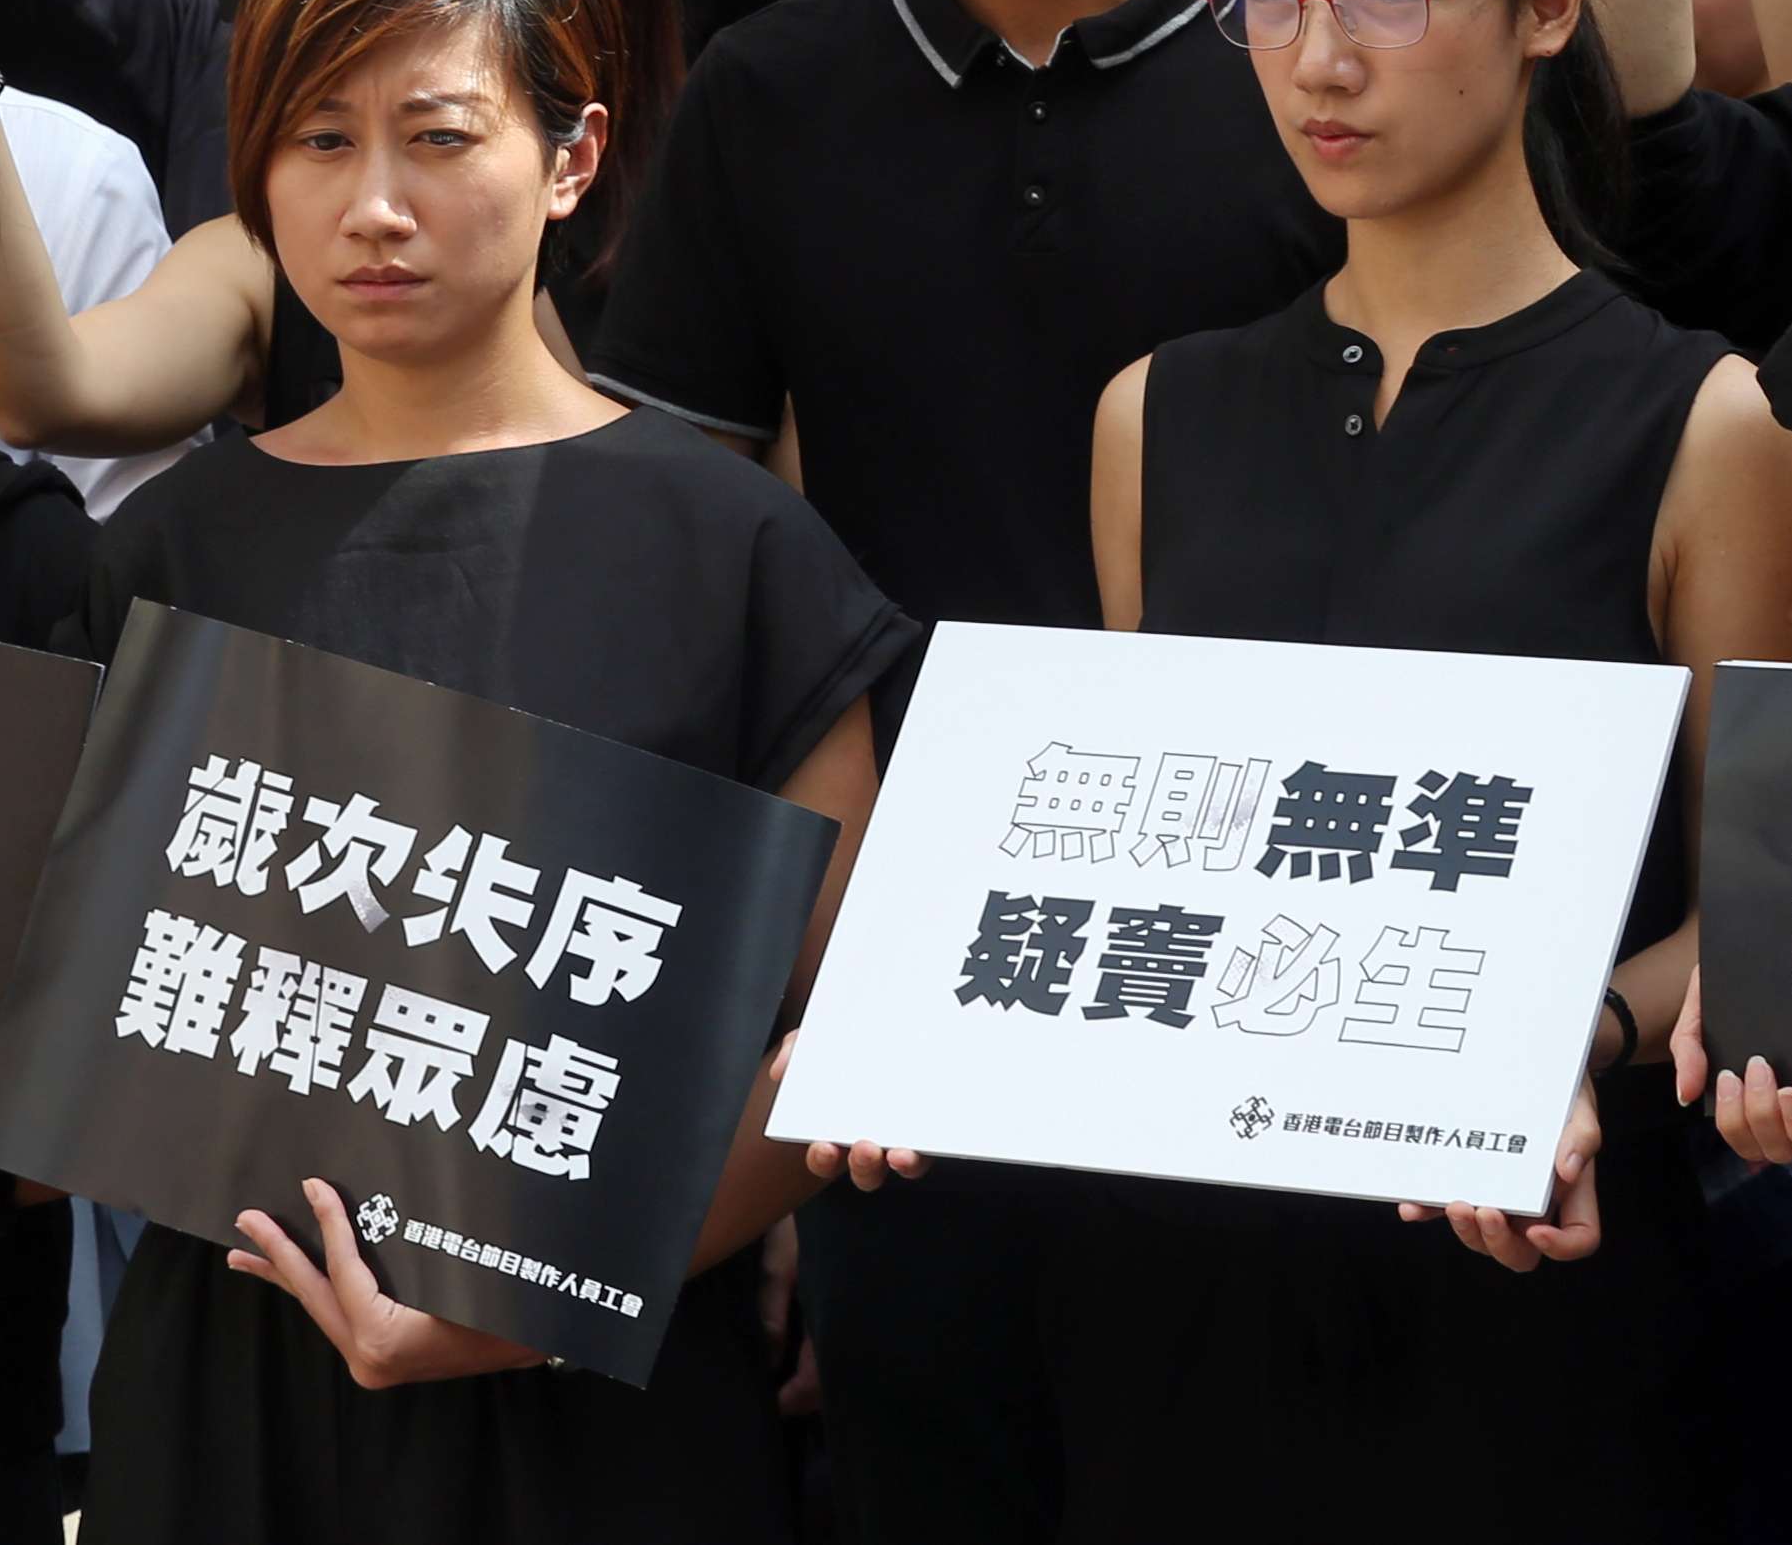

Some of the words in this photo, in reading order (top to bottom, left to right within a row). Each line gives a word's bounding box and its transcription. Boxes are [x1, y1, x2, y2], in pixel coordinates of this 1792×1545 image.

[165, 754, 682, 1007] 歲次失序
[999, 741, 1533, 892] 無則無準
[113, 908, 621, 1181] 難釋眾慮
[953, 890, 1486, 1053] 疑竇必生
[1282, 1111, 1529, 1155] 香港電台節目製作人員工會
[403, 1218, 645, 1319] 香港電台節目製作人員工會
